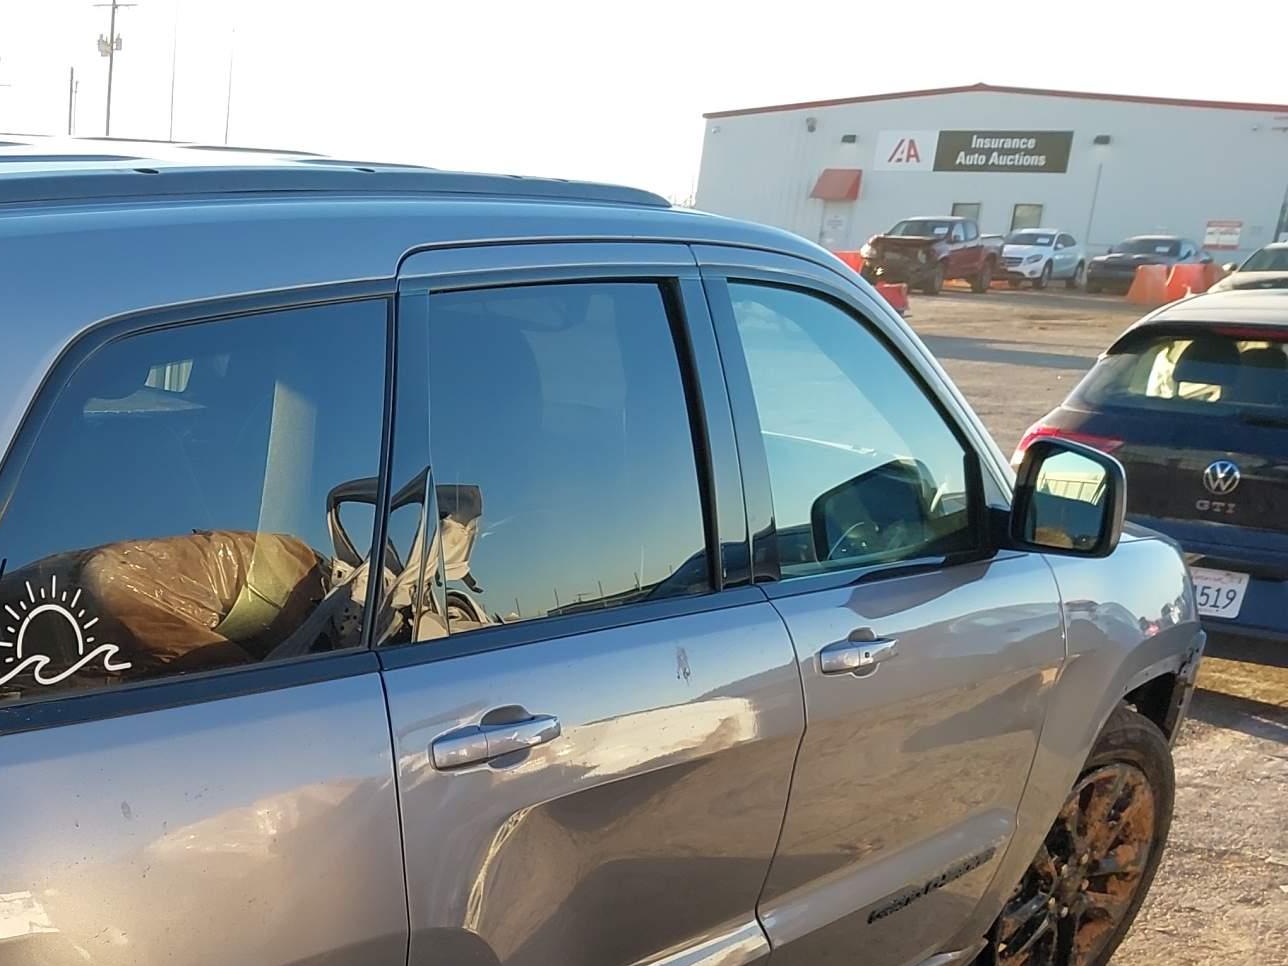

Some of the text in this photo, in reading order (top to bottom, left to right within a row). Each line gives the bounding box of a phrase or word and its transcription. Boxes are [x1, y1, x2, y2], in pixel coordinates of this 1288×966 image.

[971, 134, 1036, 149] Insurance
[955, 151, 1047, 167] Auto Auctions
[1195, 499, 1237, 514] GTI
